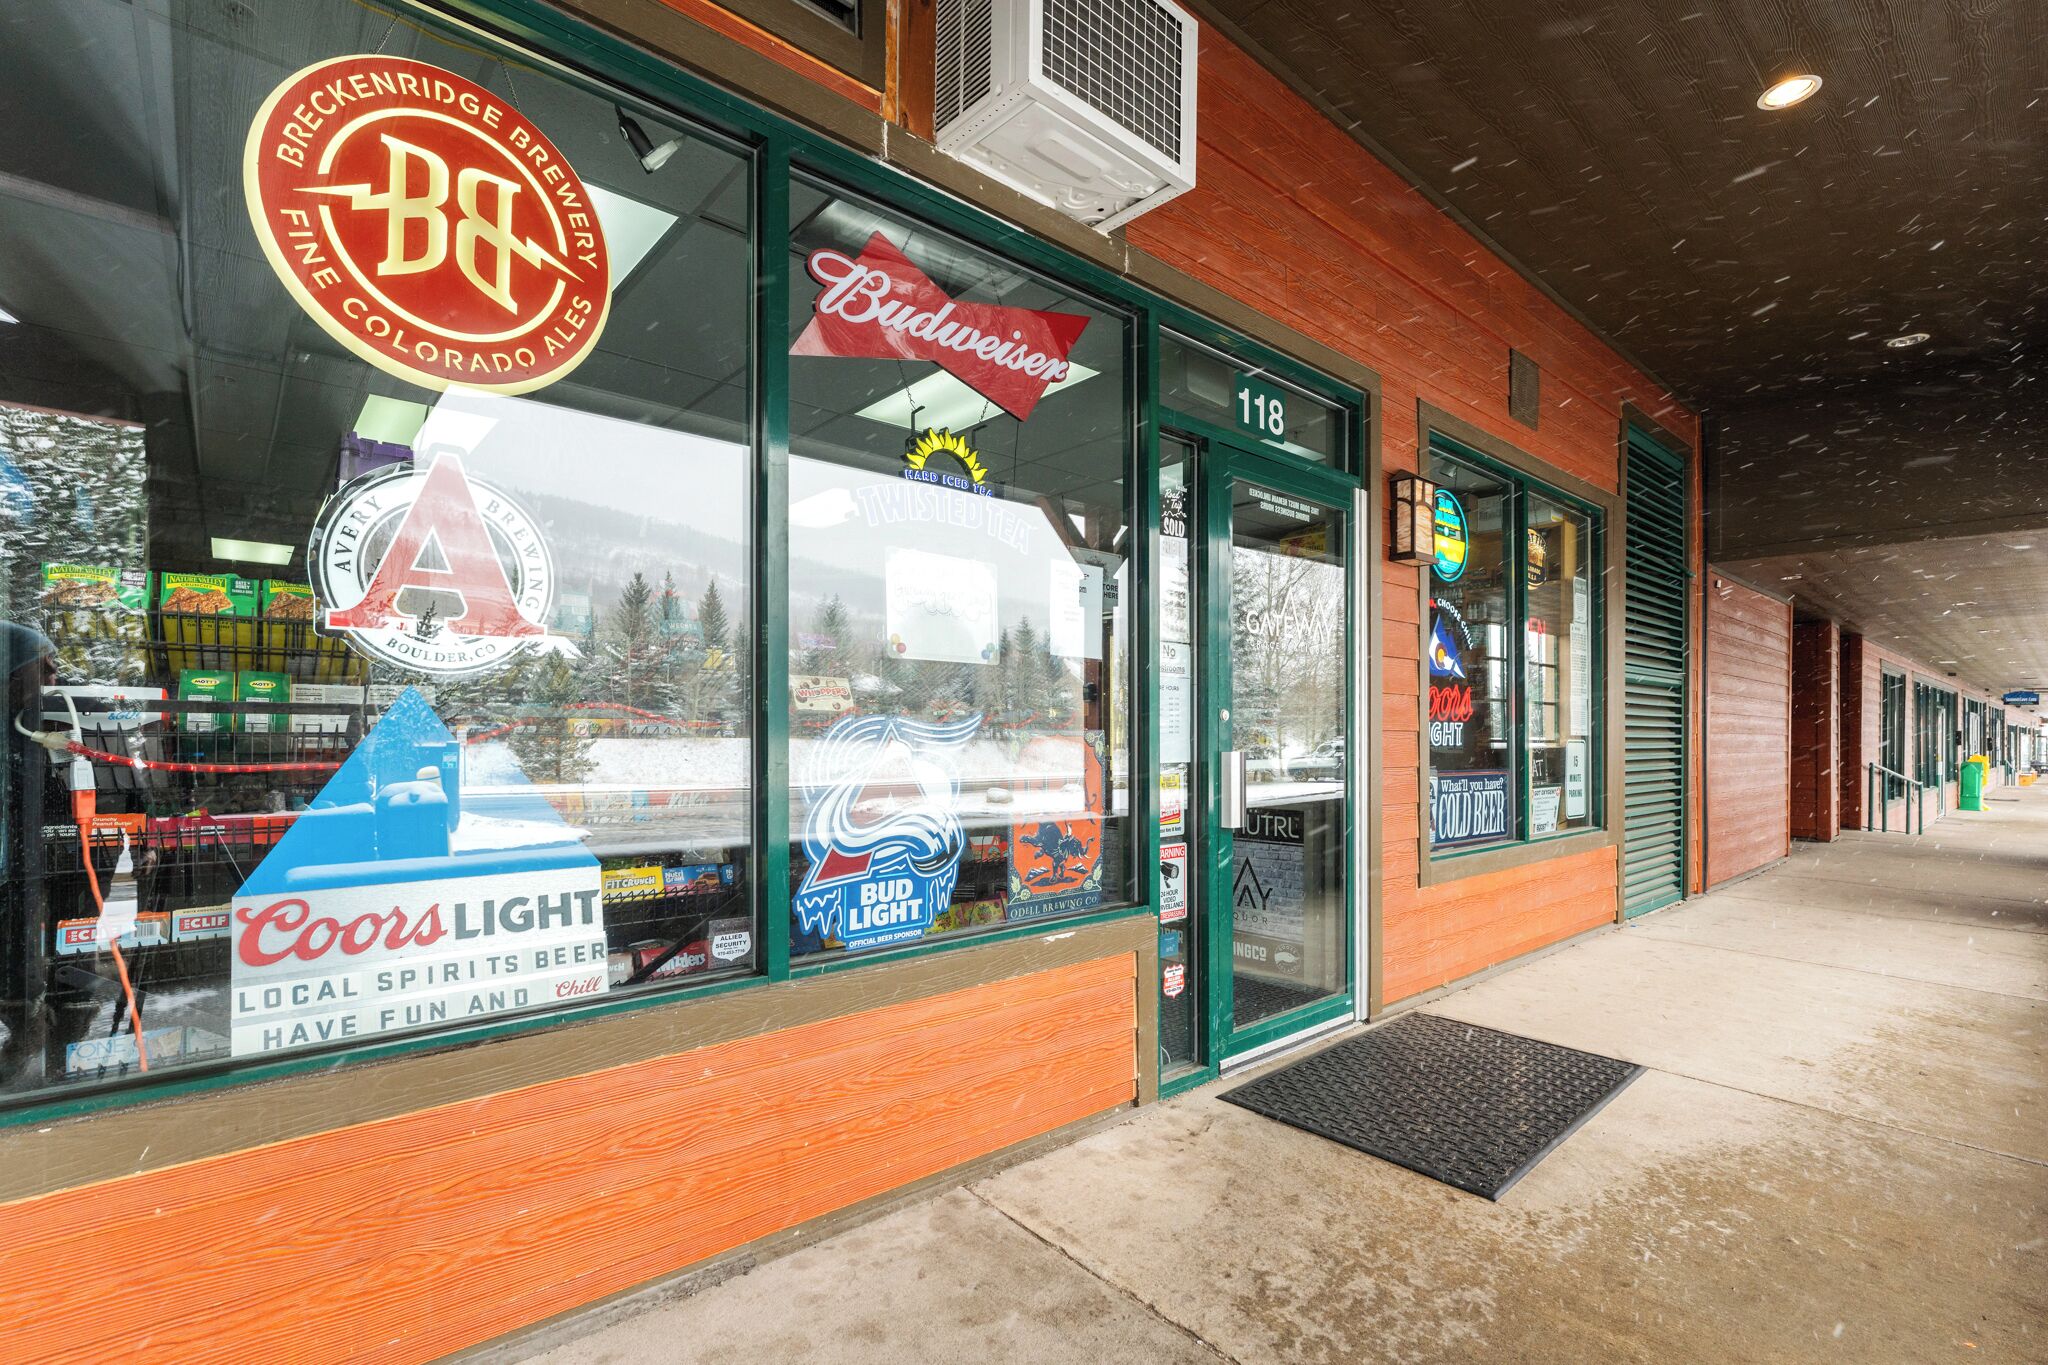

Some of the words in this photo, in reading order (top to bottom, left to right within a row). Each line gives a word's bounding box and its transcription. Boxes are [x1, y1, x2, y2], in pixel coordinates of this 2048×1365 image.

[276, 71, 503, 168] BRECKENRIDGE
[509, 125, 598, 269] BREWERY
[280, 208, 342, 290] FINE
[342, 297, 536, 374] COLORADO
[543, 295, 592, 356] ALES
[811, 252, 1067, 381] Budweiser
[1238, 388, 1285, 436] 118
[904, 469, 939, 483] HARD
[942, 474, 970, 490] ICED
[973, 483, 993, 498] TEA
[856, 483, 984, 529] TWISTED
[986, 501, 1030, 555] TEA
[1163, 516, 1185, 538] SOLD
[334, 495, 384, 574] AVERY
[485, 500, 543, 612] BREWING
[169, 575, 198, 584] NATURE
[198, 576, 224, 587] VALLEY
[1246, 585, 1334, 645] GATEWAY
[1437, 598, 1462, 622] CHOOSE
[1461, 620, 1474, 650] CHILL
[475, 642, 497, 660] CO
[1163, 645, 1176, 658] No
[796, 686, 849, 698] WHOPPERS
[1429, 721, 1464, 747] GHT
[1573, 755, 1579, 768] 15
[1441, 778, 1468, 793] What'll
[1469, 780, 1483, 794] you
[1484, 777, 1504, 790] have?
[1569, 773, 1582, 783] MINUTE
[1568, 788, 1583, 799] PARKING
[1233, 809, 1300, 839] ÜTRL
[1438, 792, 1472, 839] COLD
[1472, 790, 1505, 836] BEER
[1160, 846, 1185, 859] ARNING
[860, 878, 914, 907] BUD
[1163, 895, 1177, 904] VIDEO
[1165, 888, 1179, 896] HOUR
[1010, 905, 1041, 919] ODELL
[1042, 897, 1083, 913] BREWING
[189, 914, 228, 929] CLIF
[235, 898, 447, 967] Coors
[454, 888, 601, 941] LIGHT
[77, 928, 100, 941] CL
[715, 940, 747, 949] SECURITY
[720, 933, 743, 941] ALLIED
[848, 937, 877, 948] OFFICIAL
[877, 934, 893, 943] BEER
[893, 929, 922, 940] SPONSOR
[238, 977, 359, 1014] LOCAL
[377, 954, 519, 992] SPIRITS
[534, 941, 606, 970] BEER
[555, 975, 603, 999] Chill
[262, 1014, 358, 1051] HAVE
[380, 1000, 447, 1030] FUN
[467, 988, 529, 1015] AND
